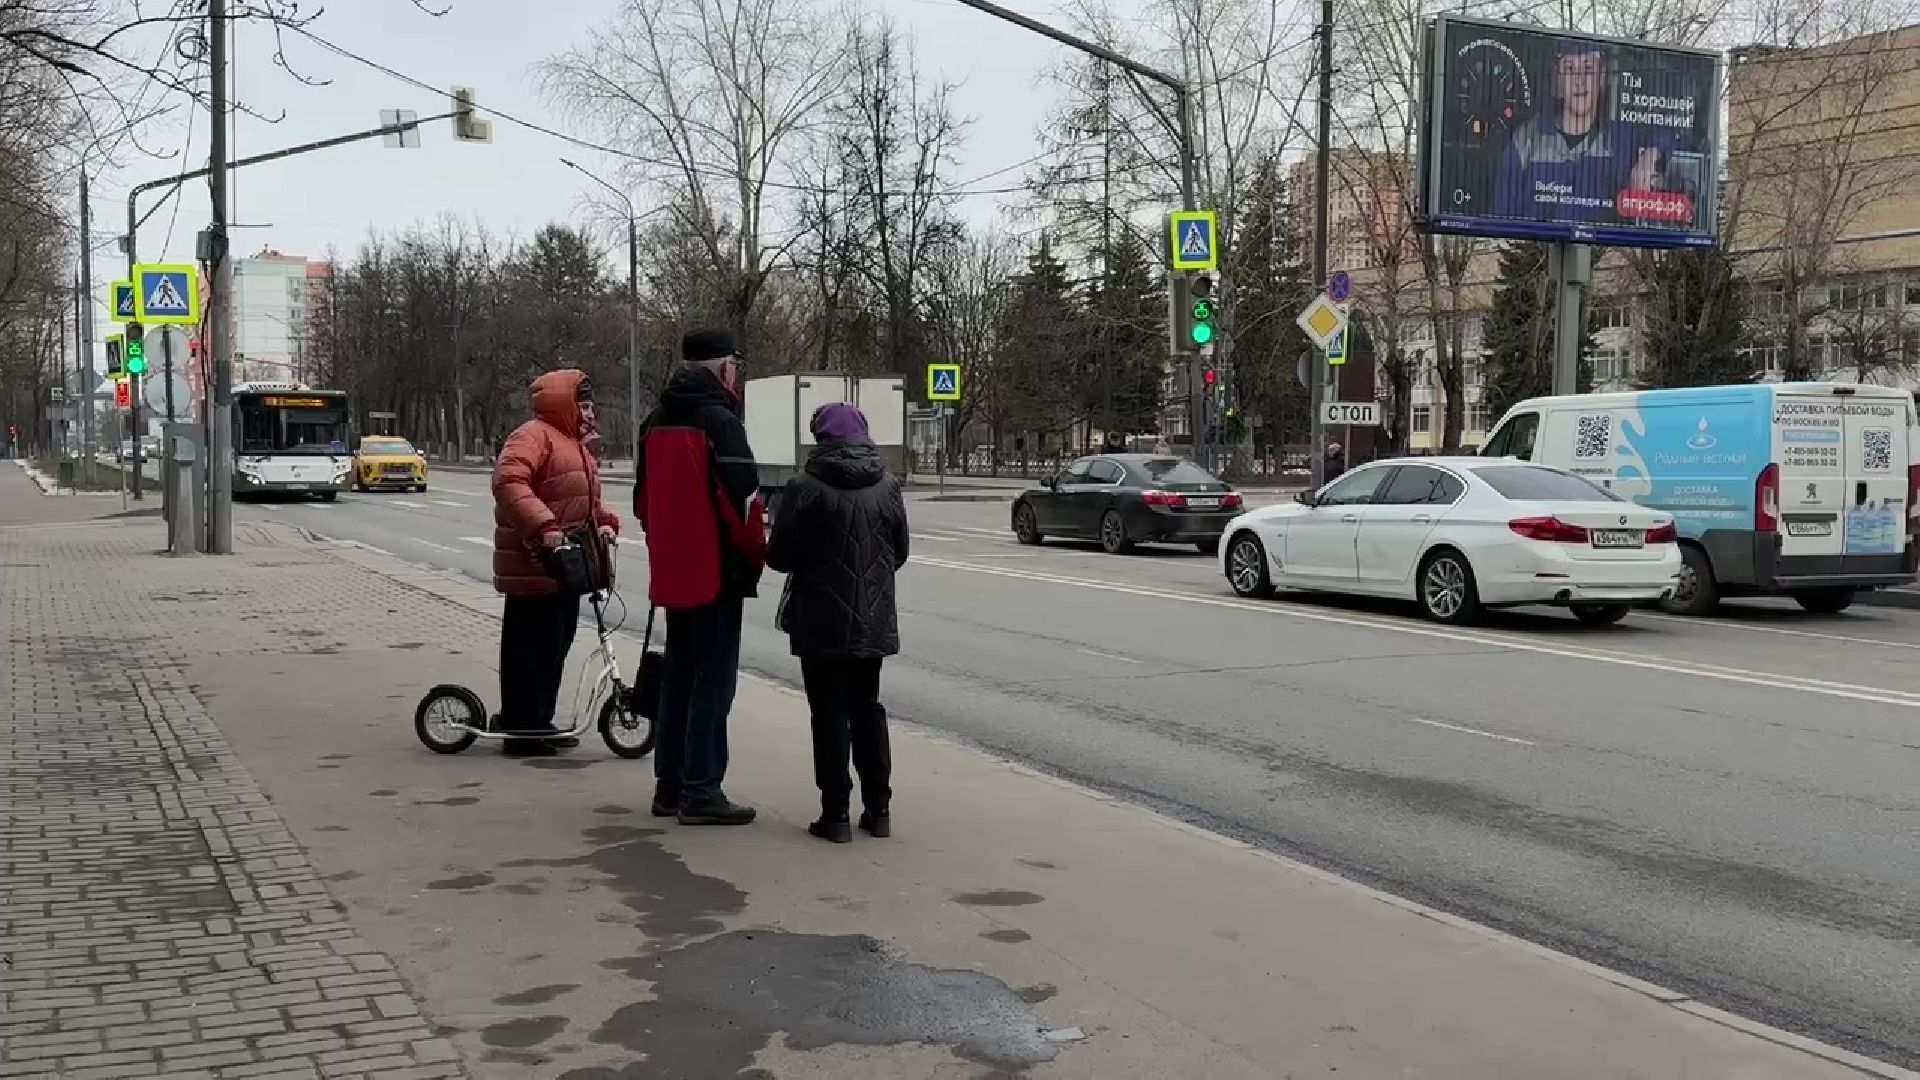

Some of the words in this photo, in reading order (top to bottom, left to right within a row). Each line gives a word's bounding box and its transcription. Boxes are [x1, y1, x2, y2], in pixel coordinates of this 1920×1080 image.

[1622, 72, 1642, 88] Ты
[1622, 92, 1630, 104] в
[1632, 93, 1695, 111] хорошей
[1620, 110, 1694, 128] компании!
[1535, 181, 1573, 195] Выбери
[1328, 405, 1372, 421] СТОП
[1781, 404, 1825, 415] ДОСТАВКА
[1826, 404, 1869, 416] ПИТЬЕВОЙ
[1871, 407, 1895, 417] ВОДЫ
